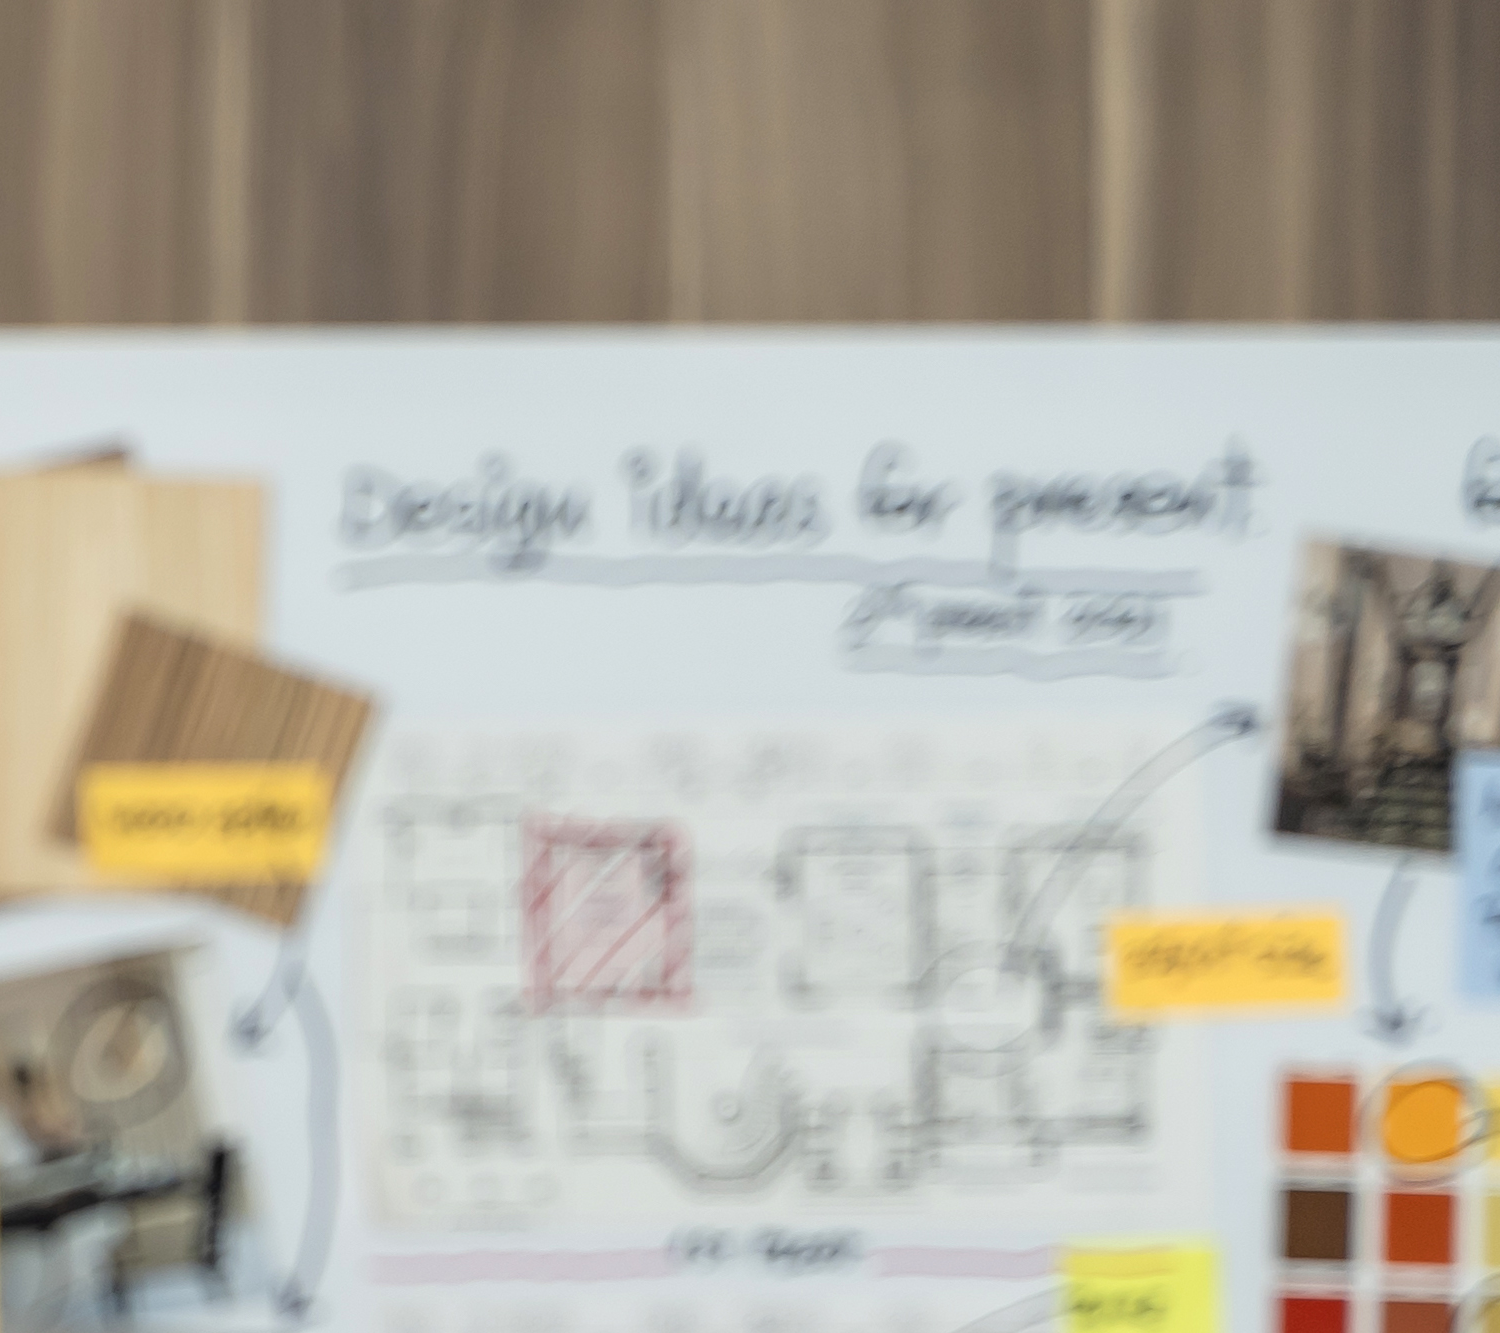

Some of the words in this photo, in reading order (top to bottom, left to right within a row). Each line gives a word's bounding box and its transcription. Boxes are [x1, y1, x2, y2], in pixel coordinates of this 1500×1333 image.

[337, 450, 591, 578] Design
[617, 442, 829, 548] ideas
[857, 438, 953, 538] for
